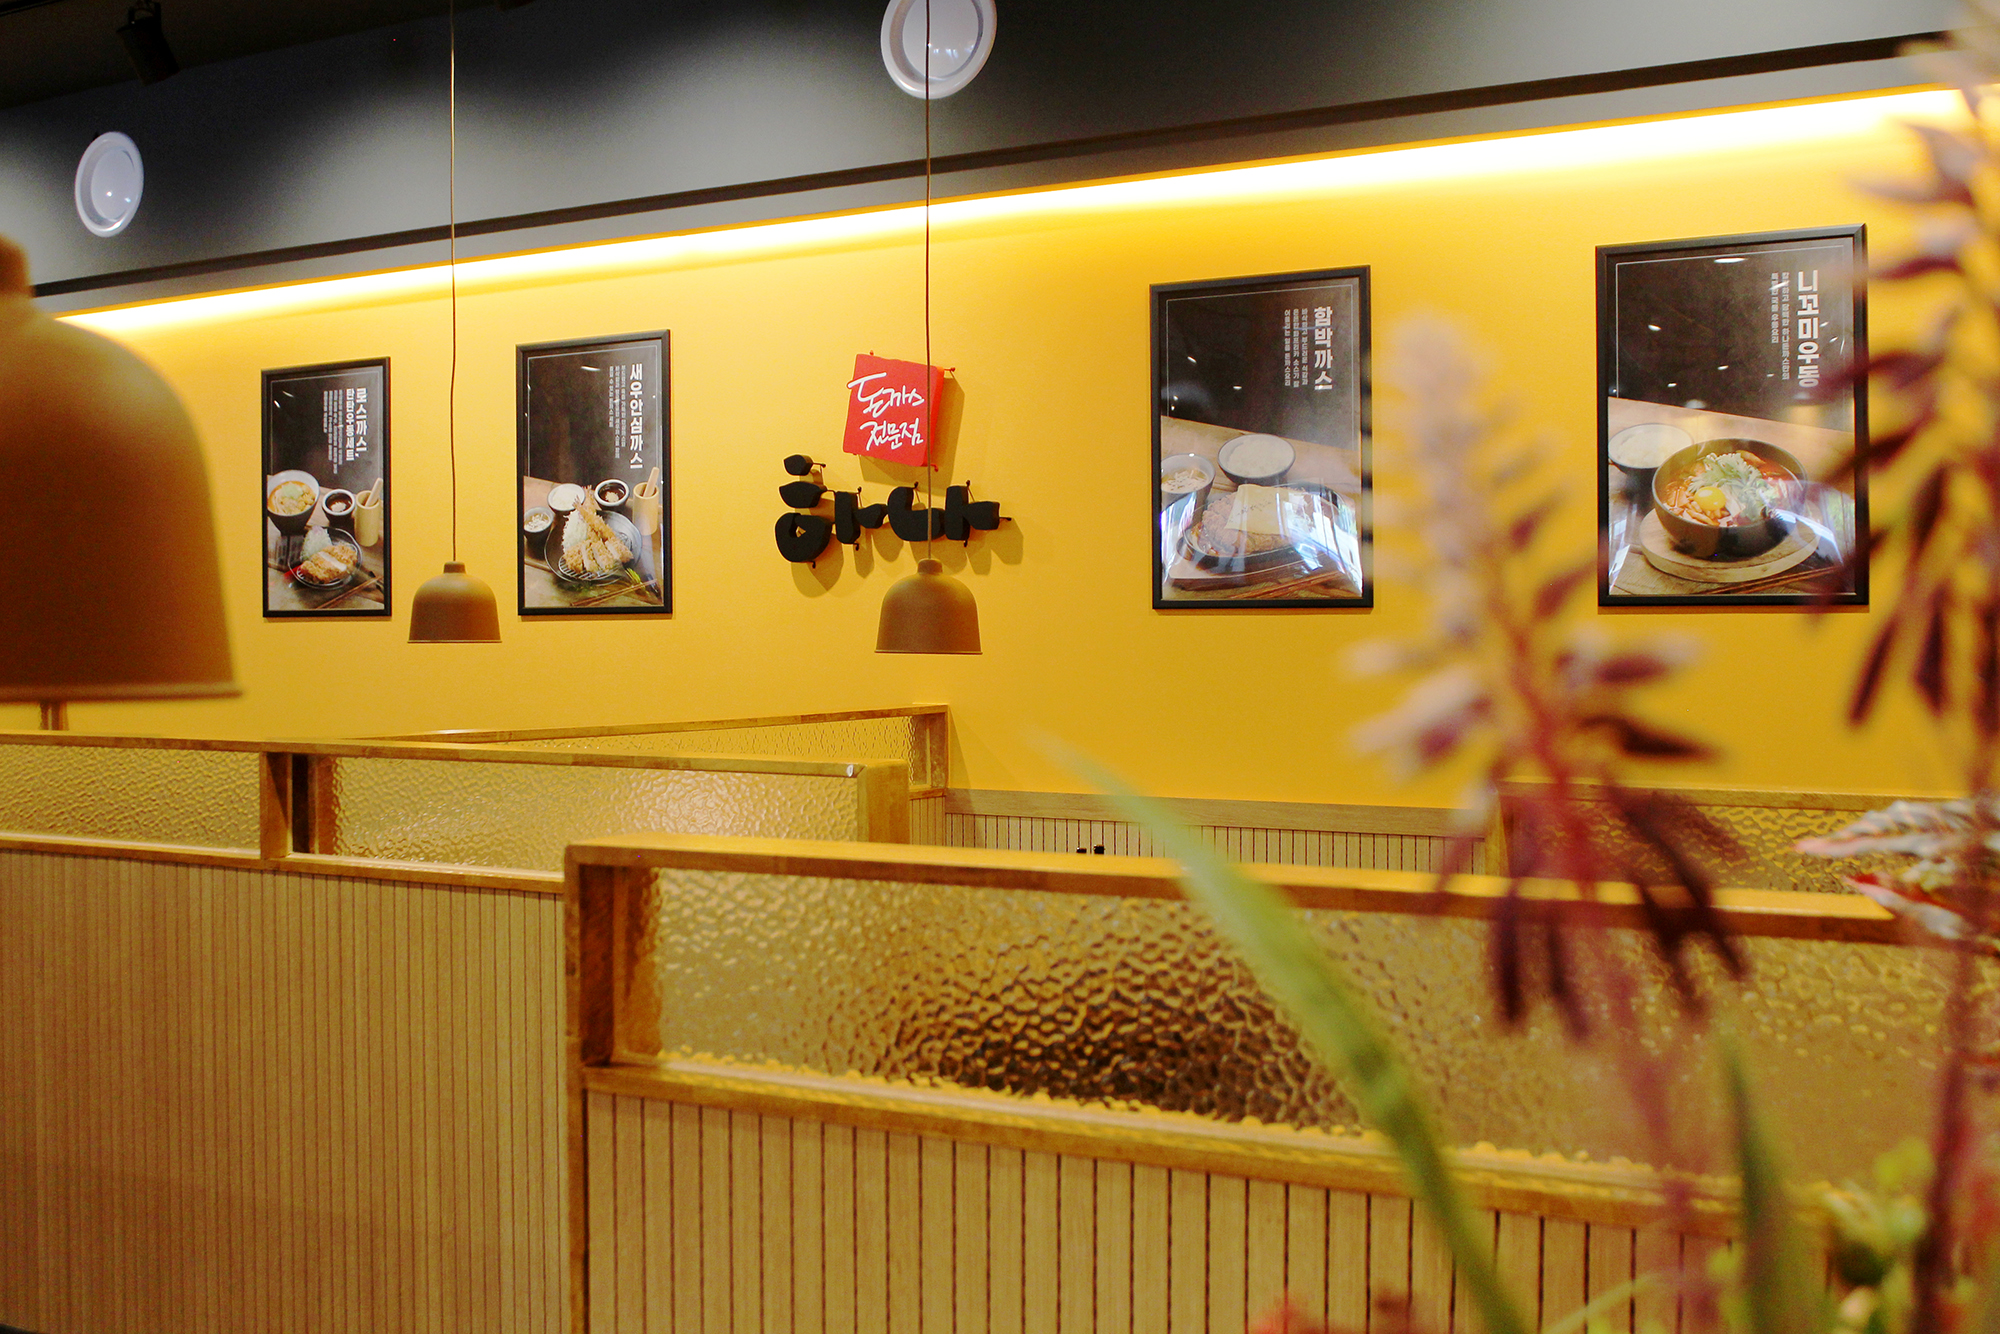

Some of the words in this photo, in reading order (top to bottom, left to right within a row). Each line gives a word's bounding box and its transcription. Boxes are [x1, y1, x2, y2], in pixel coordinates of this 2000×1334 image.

[1314, 306, 1333, 390] 함박까스
[1797, 270, 1819, 388] 니꼬미우동
[629, 363, 643, 469] 새우안심까스
[847, 372, 925, 418] 돈까스
[859, 417, 924, 451] 전문점
[775, 454, 1001, 563] 하나
